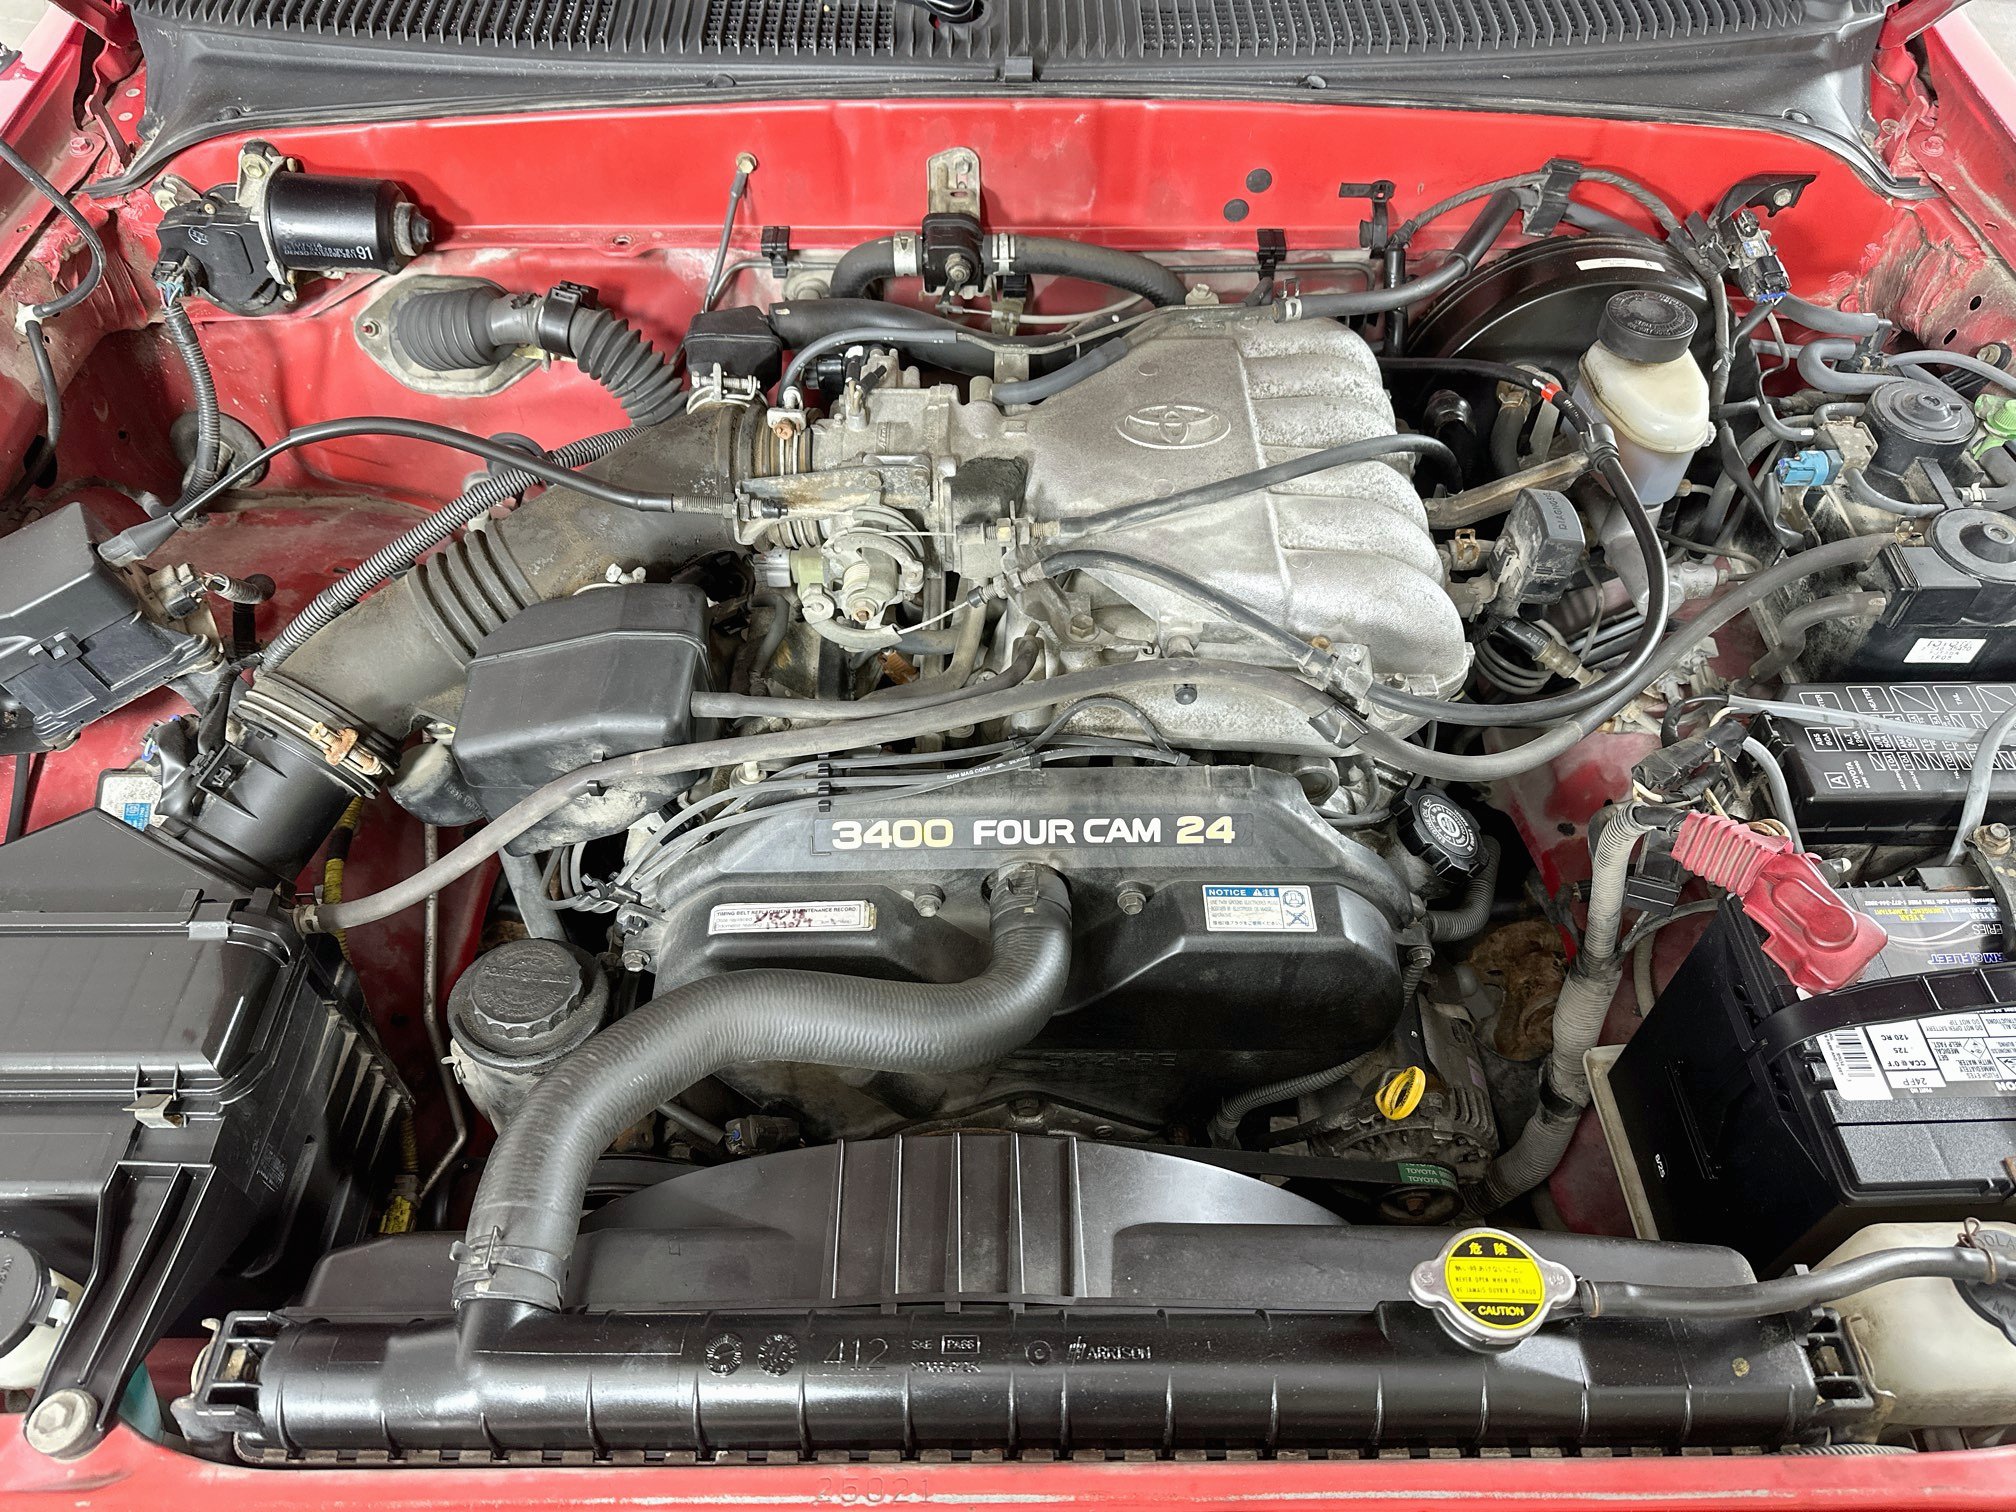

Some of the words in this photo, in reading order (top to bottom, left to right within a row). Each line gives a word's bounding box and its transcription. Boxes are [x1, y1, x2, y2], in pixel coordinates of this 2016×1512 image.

[356, 246, 374, 260] 91
[1861, 688, 1879, 711] HEATER
[1952, 692, 1963, 705] TAIL
[1813, 733, 1824, 746] ABS
[1823, 733, 1833, 746] 60A
[1843, 733, 1855, 745] ALT
[1852, 731, 1864, 746] 120A
[1886, 755, 1896, 766] 10A
[1901, 755, 1911, 766] 10A
[1945, 754, 1954, 766] 10A
[1830, 775, 1846, 785] A
[1845, 761, 1862, 788] TOYOTA
[831, 818, 954, 850] 3400
[973, 818, 1076, 846] FOUR
[1083, 817, 1161, 844] CAM
[1176, 815, 1236, 845] 24
[1971, 923, 2003, 934] ERIES
[1903, 1078, 1928, 1086] 24FP
[1405, 1167, 1438, 1175] TOYOTA
[1408, 1176, 1440, 1184] TOYOTA
[1468, 1242, 1508, 1256] 危険
[1477, 1305, 1525, 1317] CAUTION
[823, 1338, 888, 1372] 412
[812, 1477, 932, 1504] 25021
